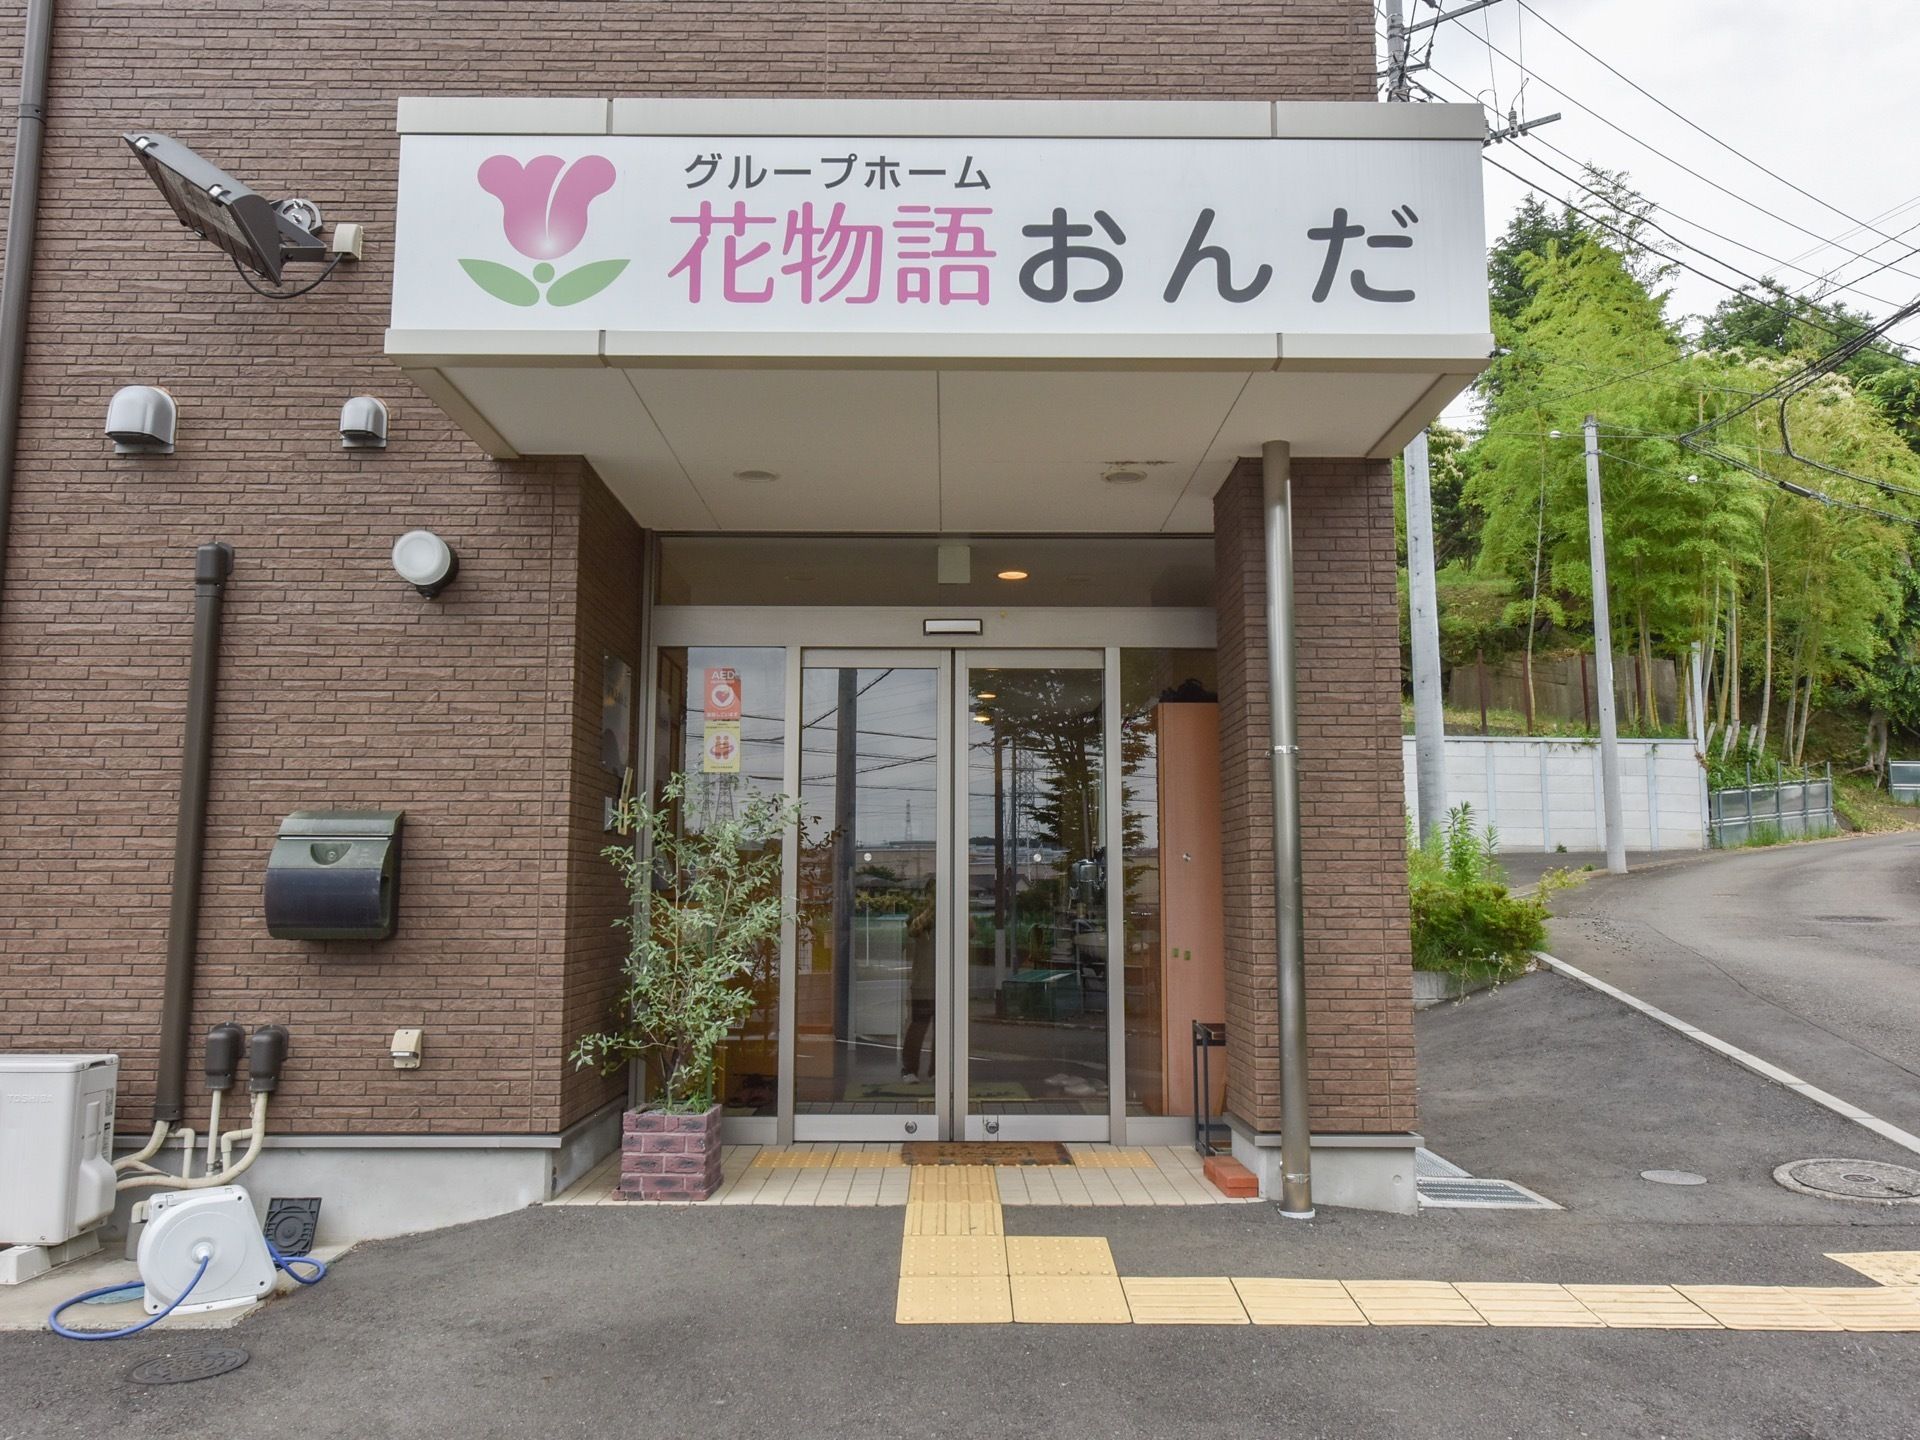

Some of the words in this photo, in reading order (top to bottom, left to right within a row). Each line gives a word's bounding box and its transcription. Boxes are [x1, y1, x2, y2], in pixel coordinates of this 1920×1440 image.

[684, 153, 991, 190] グループホーム
[668, 202, 997, 304] 花物語
[1018, 205, 1419, 304] おんだ
[711, 671, 735, 680] AED
